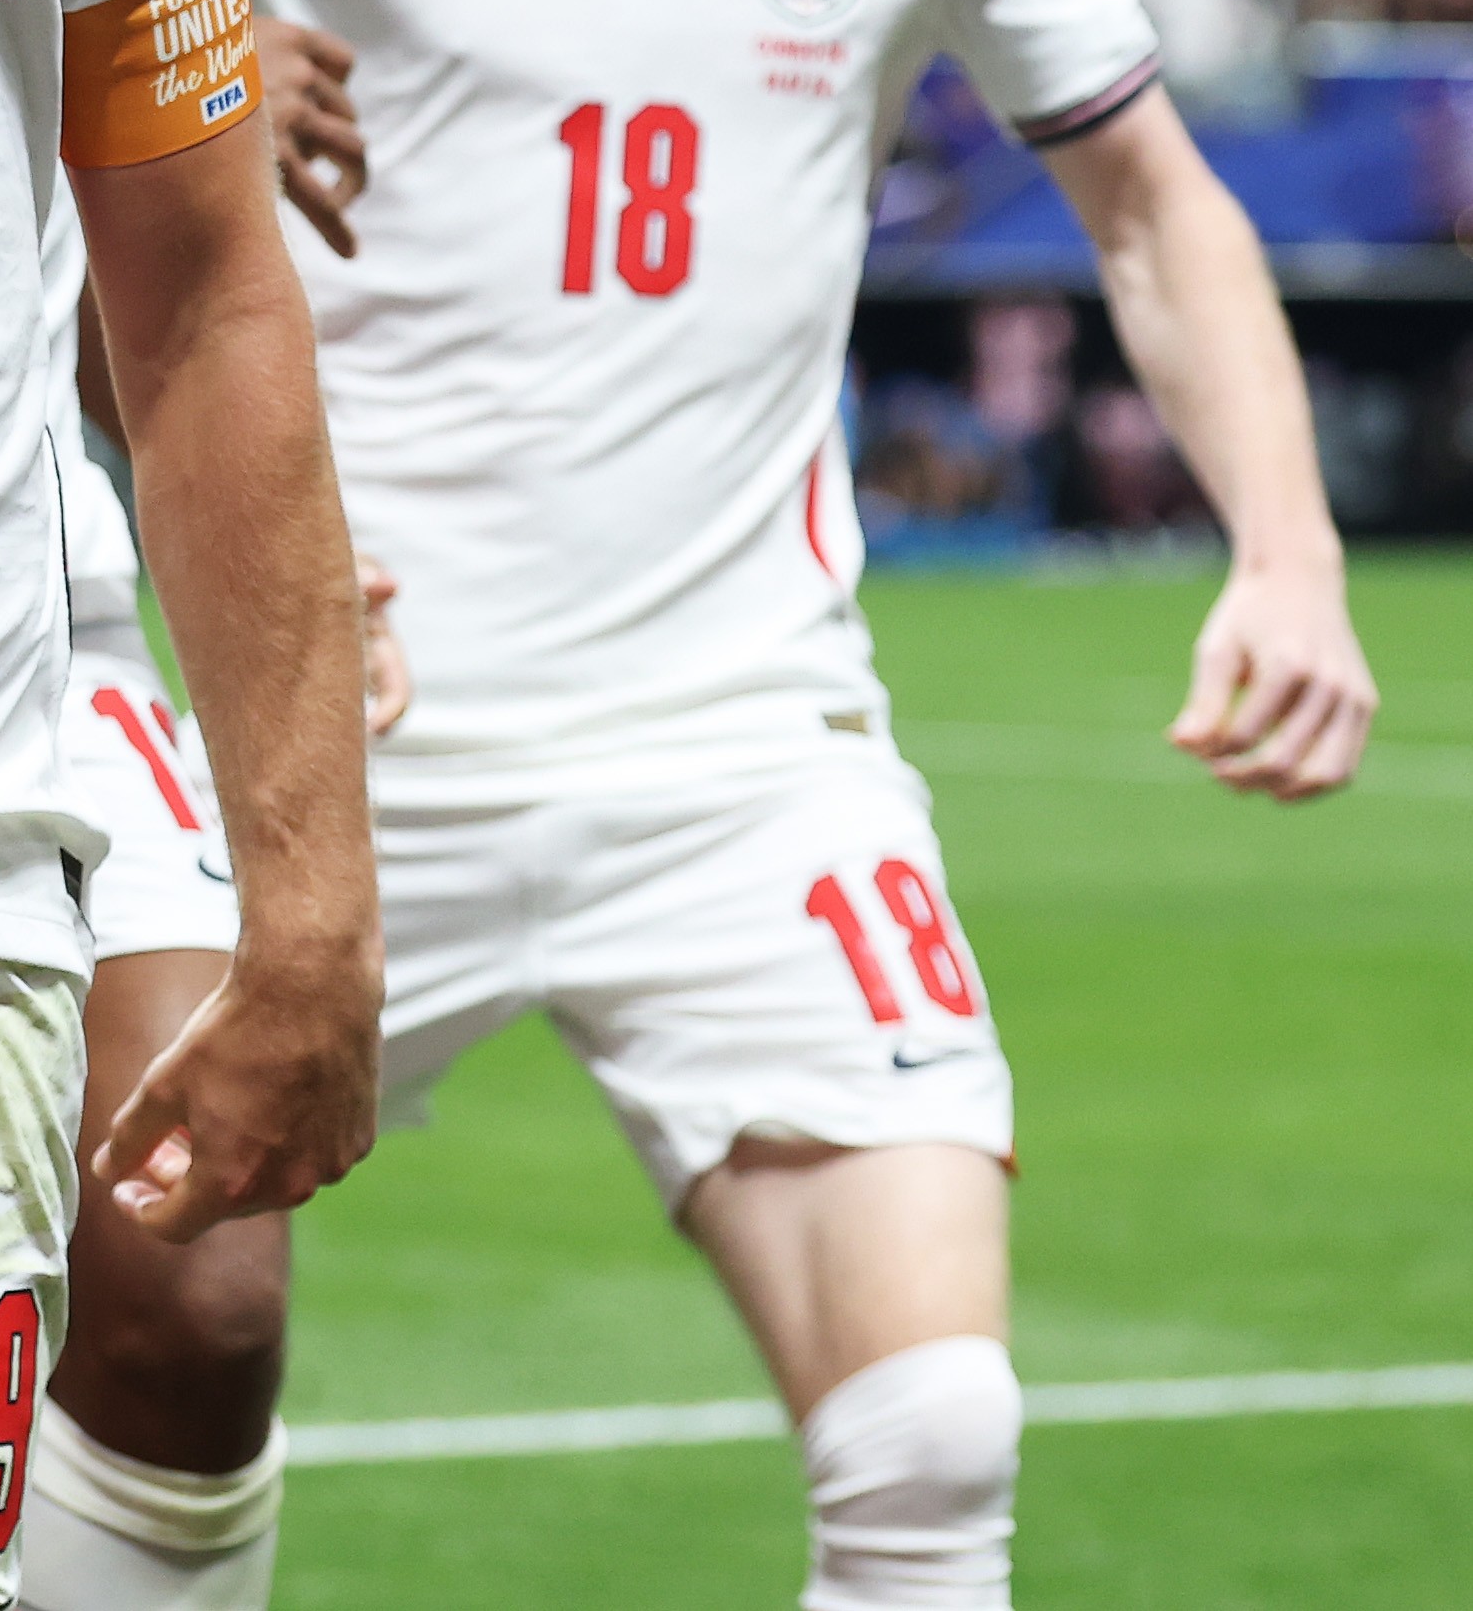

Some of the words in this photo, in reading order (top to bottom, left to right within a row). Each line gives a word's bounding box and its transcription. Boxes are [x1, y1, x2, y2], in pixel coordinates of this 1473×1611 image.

[150, 63, 205, 107] the
[205, 84, 244, 118] FIFA
[558, 102, 700, 296] 18
[90, 687, 202, 831] 1
[805, 859, 978, 1023] 18
